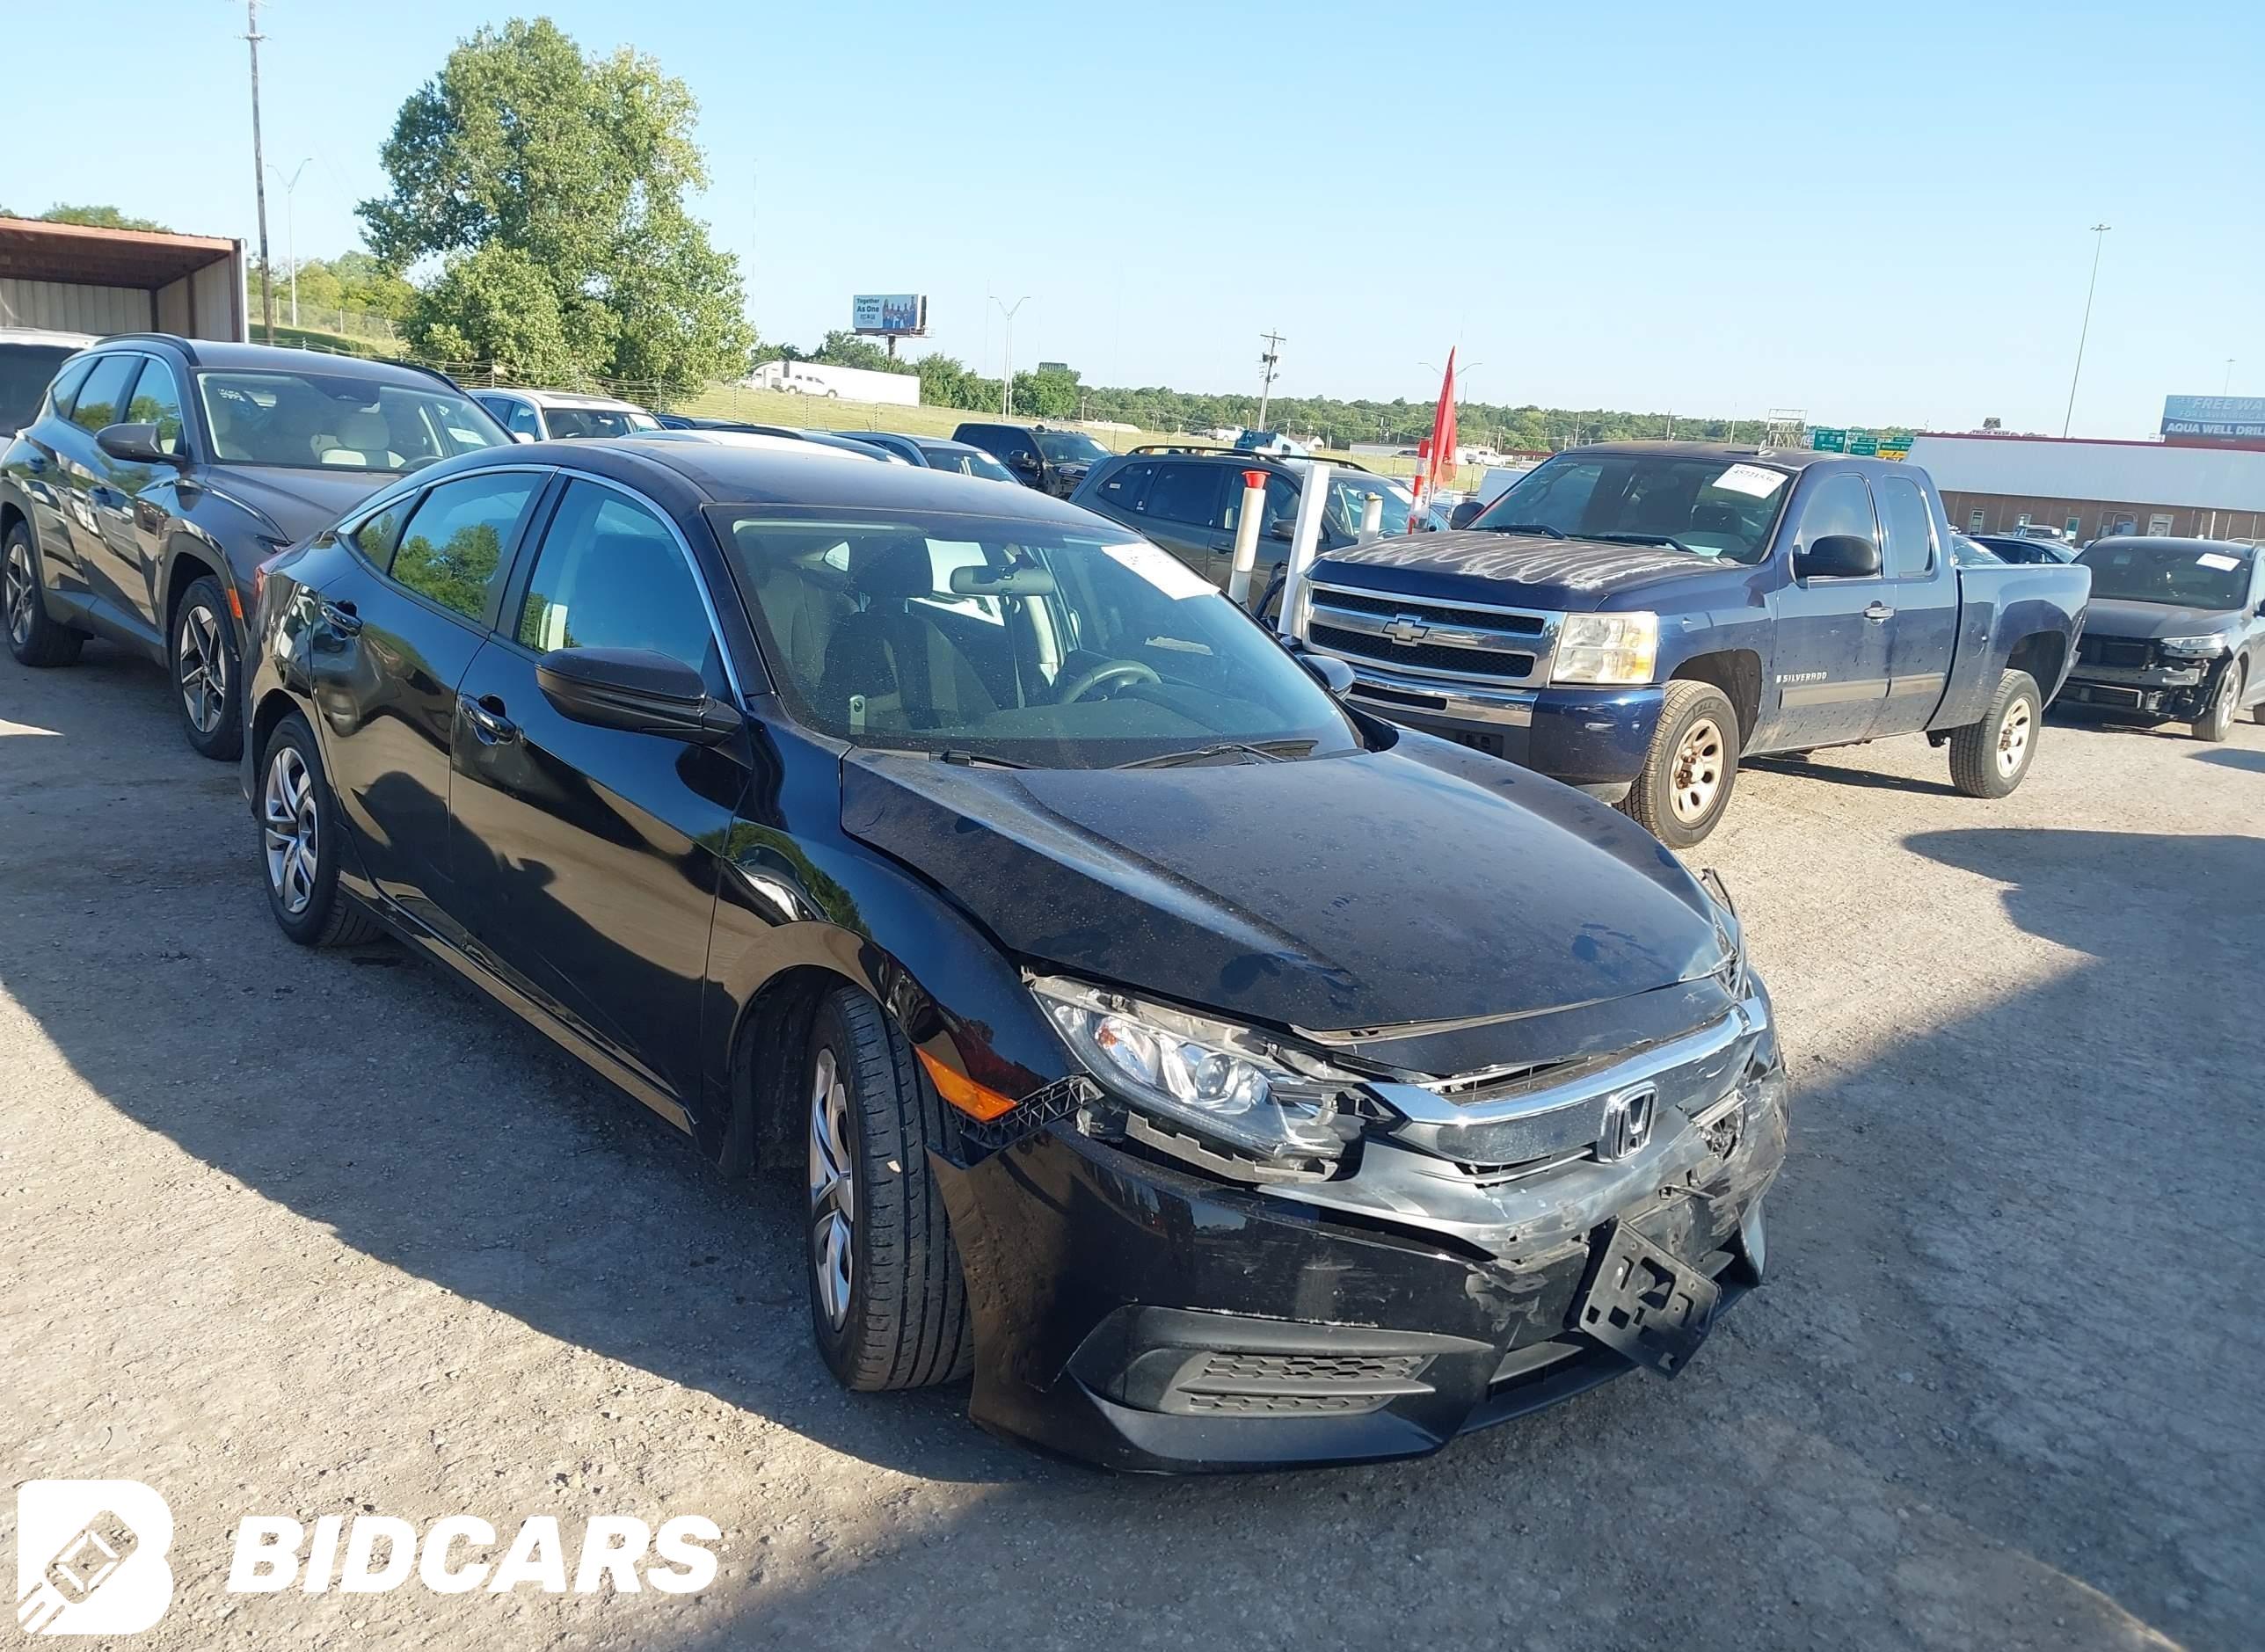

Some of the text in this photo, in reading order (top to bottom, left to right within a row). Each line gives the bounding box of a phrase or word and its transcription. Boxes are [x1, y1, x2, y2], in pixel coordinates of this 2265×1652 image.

[2192, 397, 2234, 410] FREE
[2167, 422, 2200, 433] AQUA
[2202, 424, 2234, 434] WELL
[1782, 671, 1828, 683] SILVERADO
